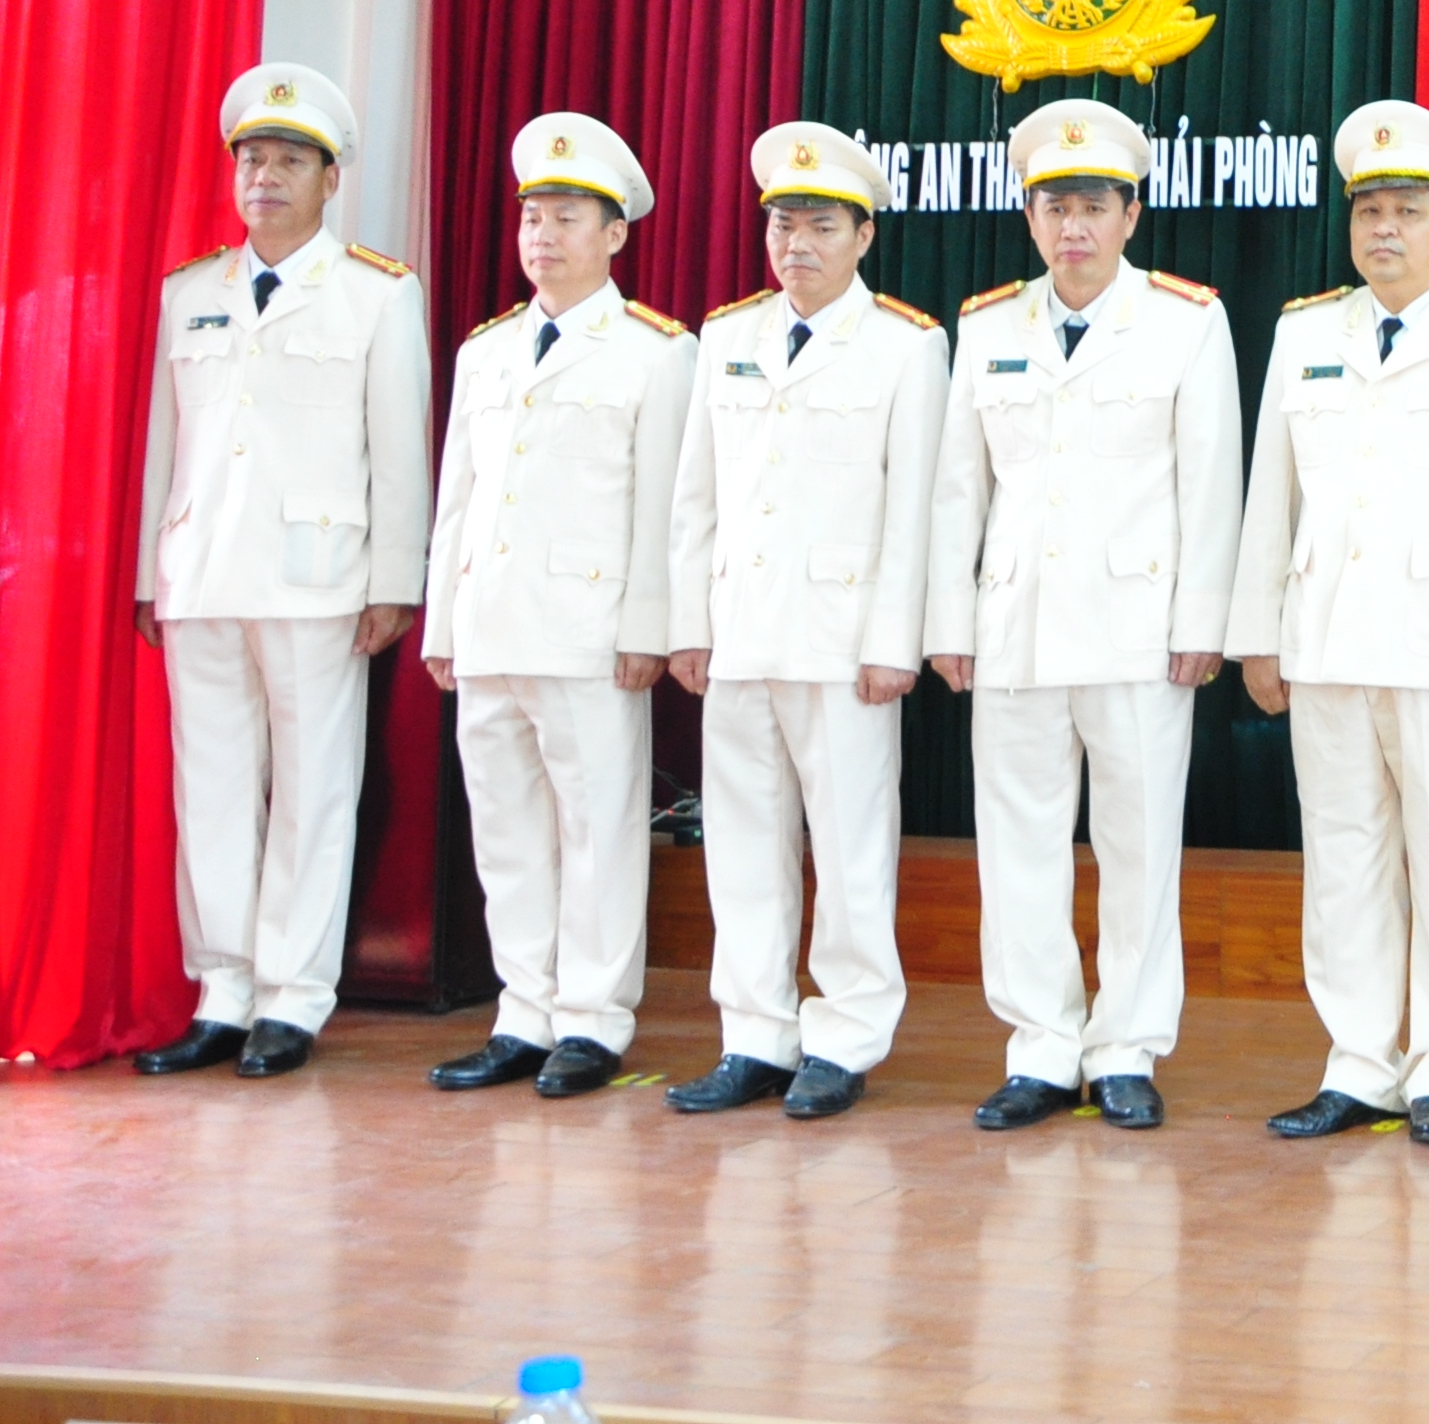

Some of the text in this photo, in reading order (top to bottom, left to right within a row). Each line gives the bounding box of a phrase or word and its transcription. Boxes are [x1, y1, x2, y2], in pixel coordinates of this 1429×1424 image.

[918, 142, 963, 212] AN
[1149, 114, 1203, 209] HẢI
[1213, 119, 1319, 208] PHÒNG
